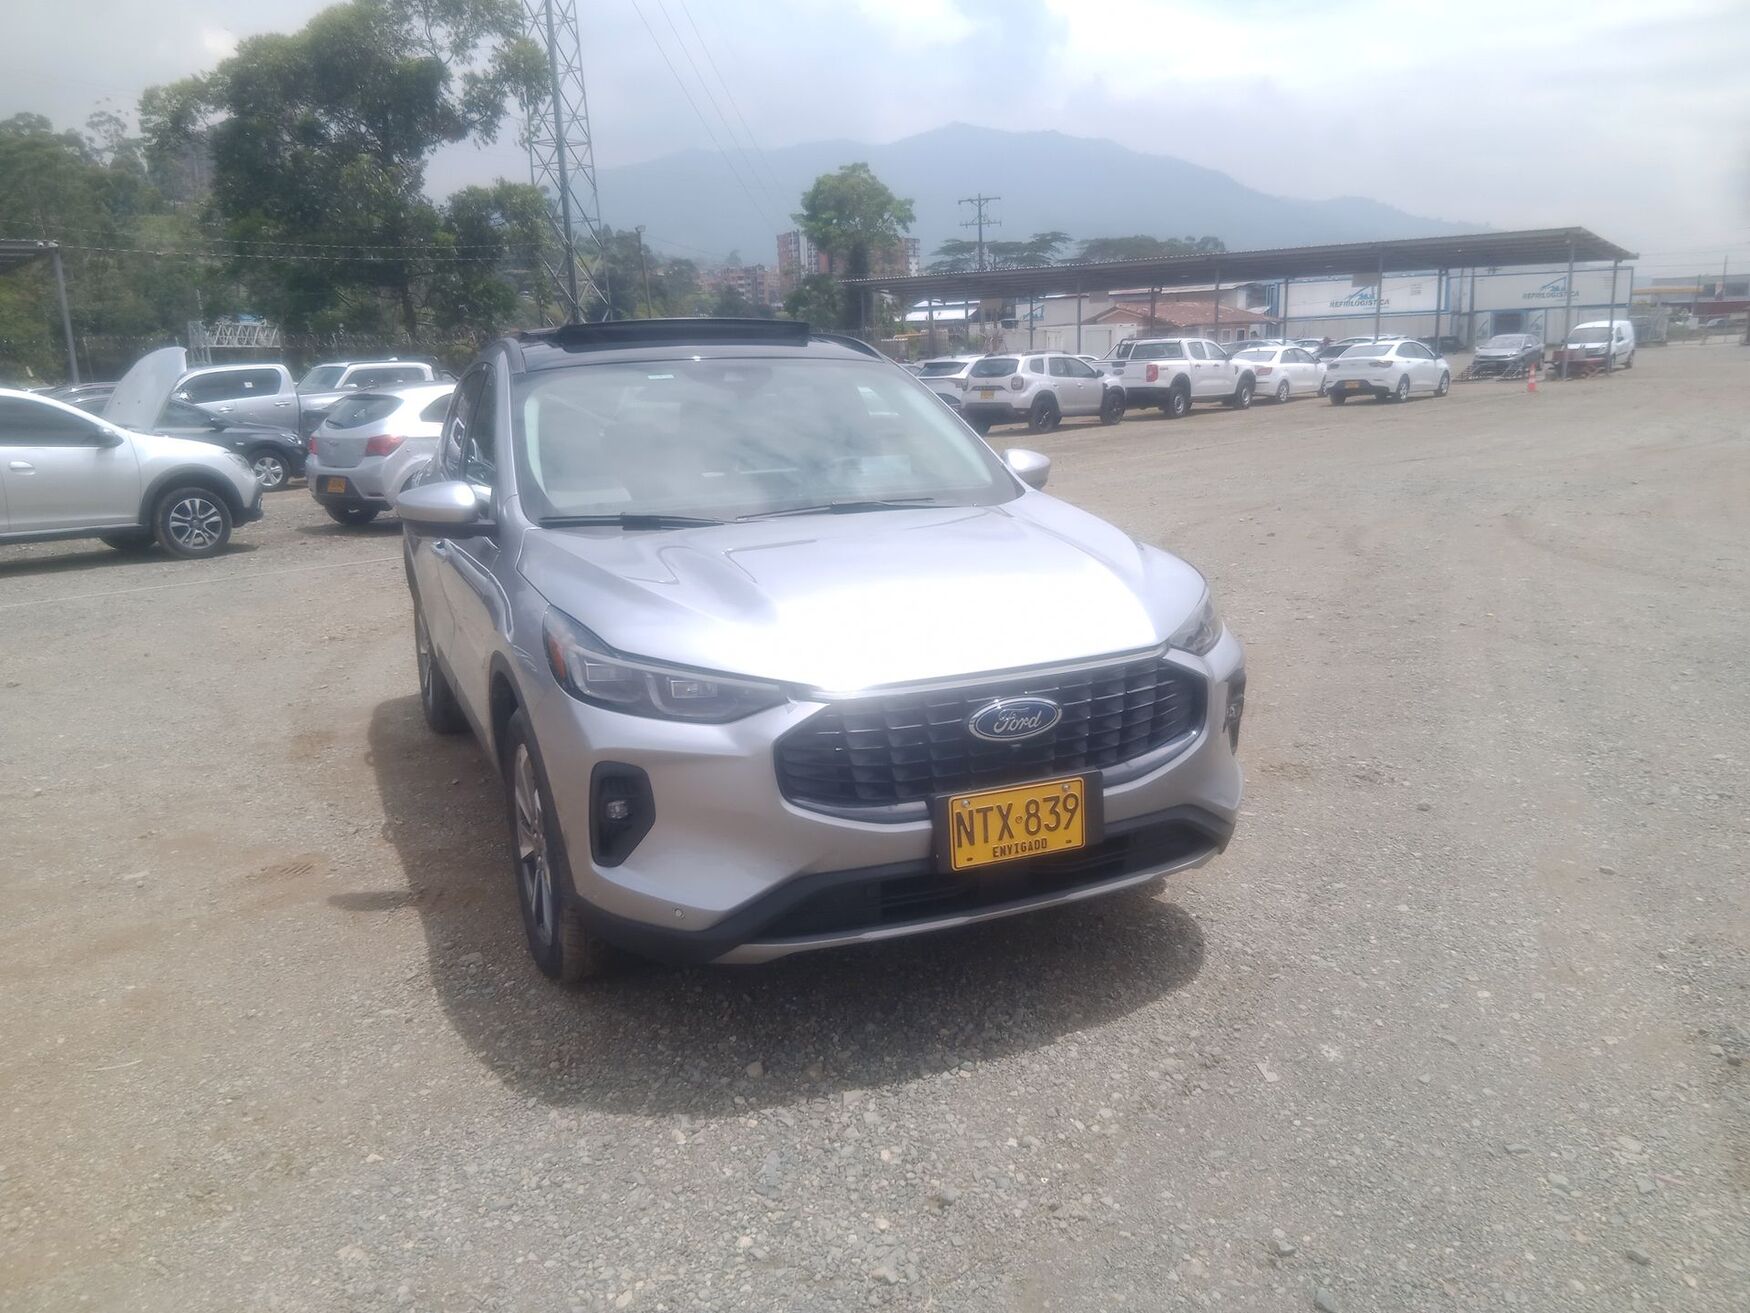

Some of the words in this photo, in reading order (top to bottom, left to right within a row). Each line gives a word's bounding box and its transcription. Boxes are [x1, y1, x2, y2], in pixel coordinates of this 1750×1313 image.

[1329, 298, 1390, 308] REFRILOGISTCA
[993, 707, 1042, 734] Ford
[992, 837, 1048, 858] ENVIGADO
